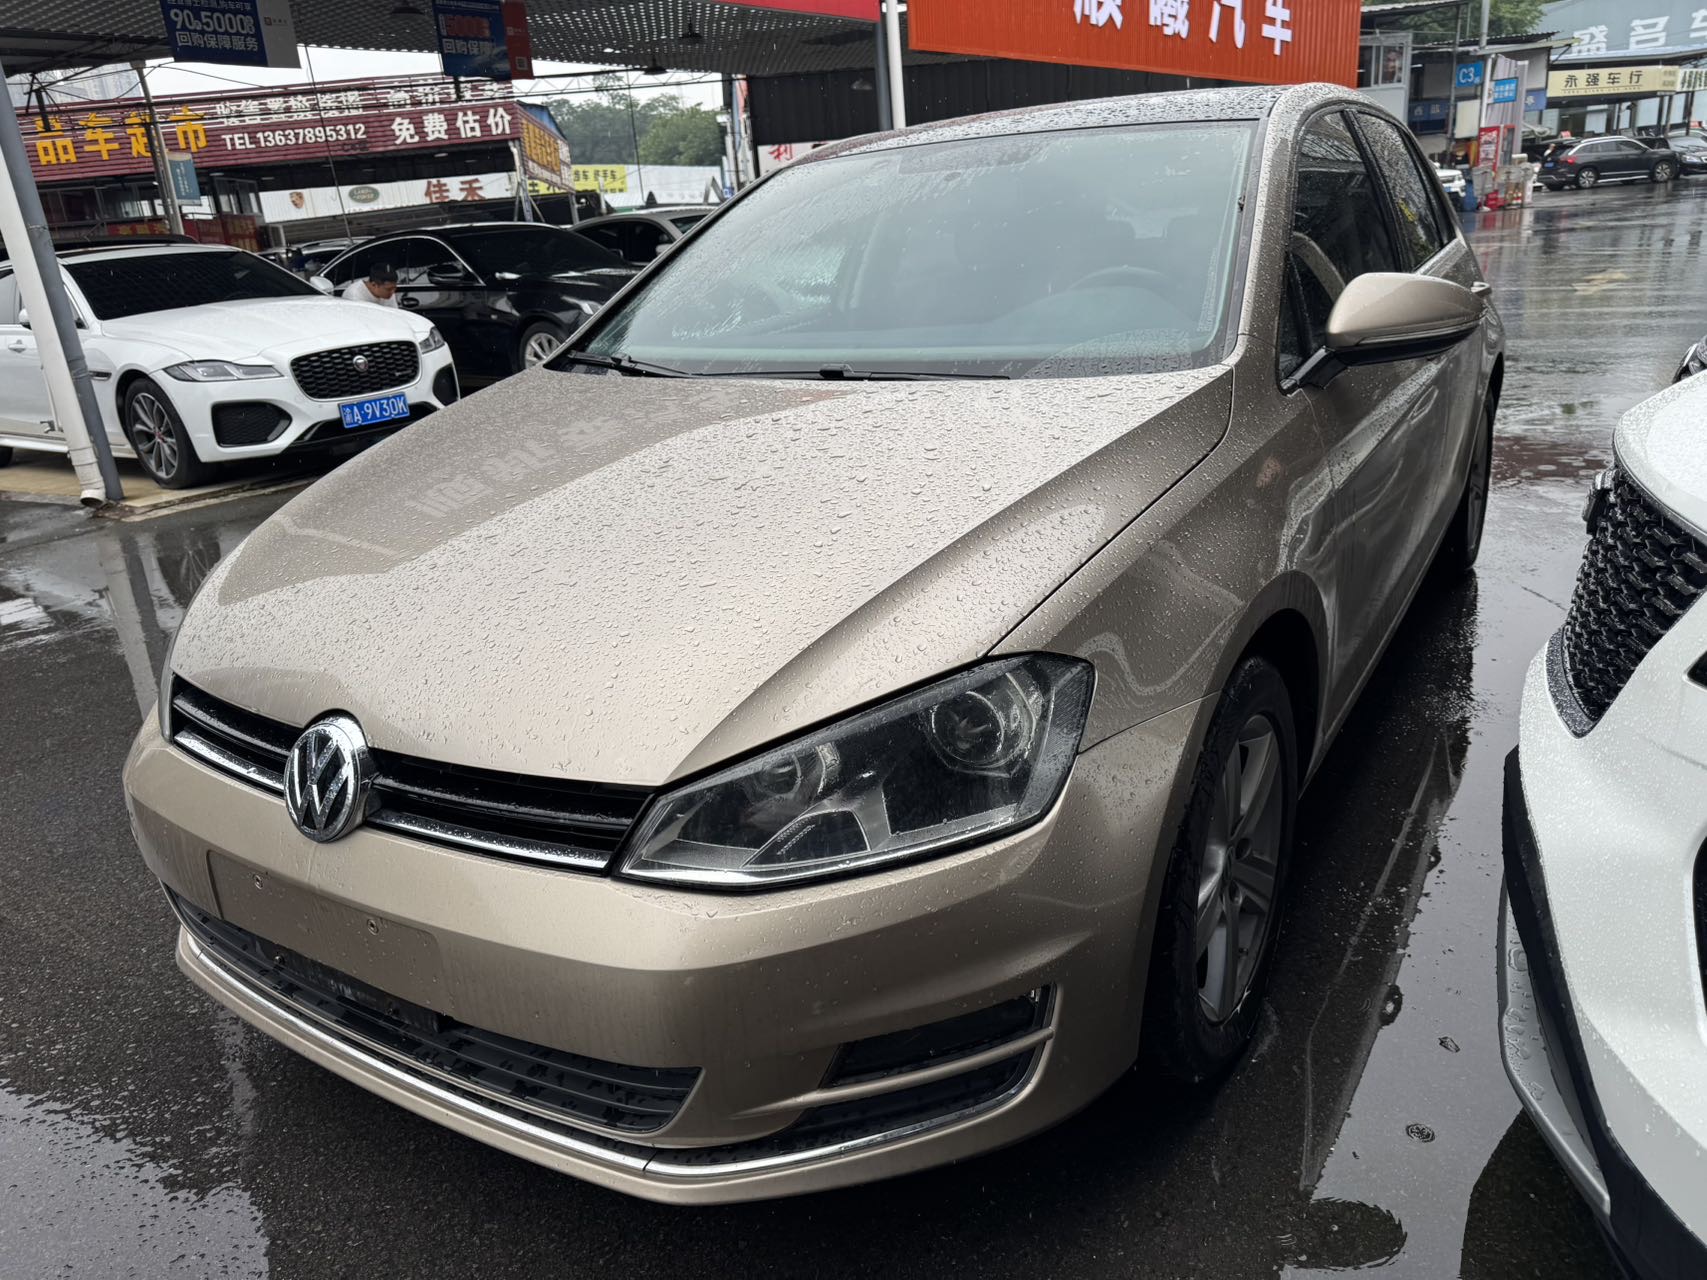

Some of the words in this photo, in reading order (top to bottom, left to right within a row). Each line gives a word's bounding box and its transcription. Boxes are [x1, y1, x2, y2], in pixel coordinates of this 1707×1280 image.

[1564, 70, 1643, 88] 永强车行
[222, 133, 256, 150] TEL
[256, 123, 367, 148] 13637895312
[391, 107, 512, 145] 免费估价
[424, 177, 486, 203] 佳禾
